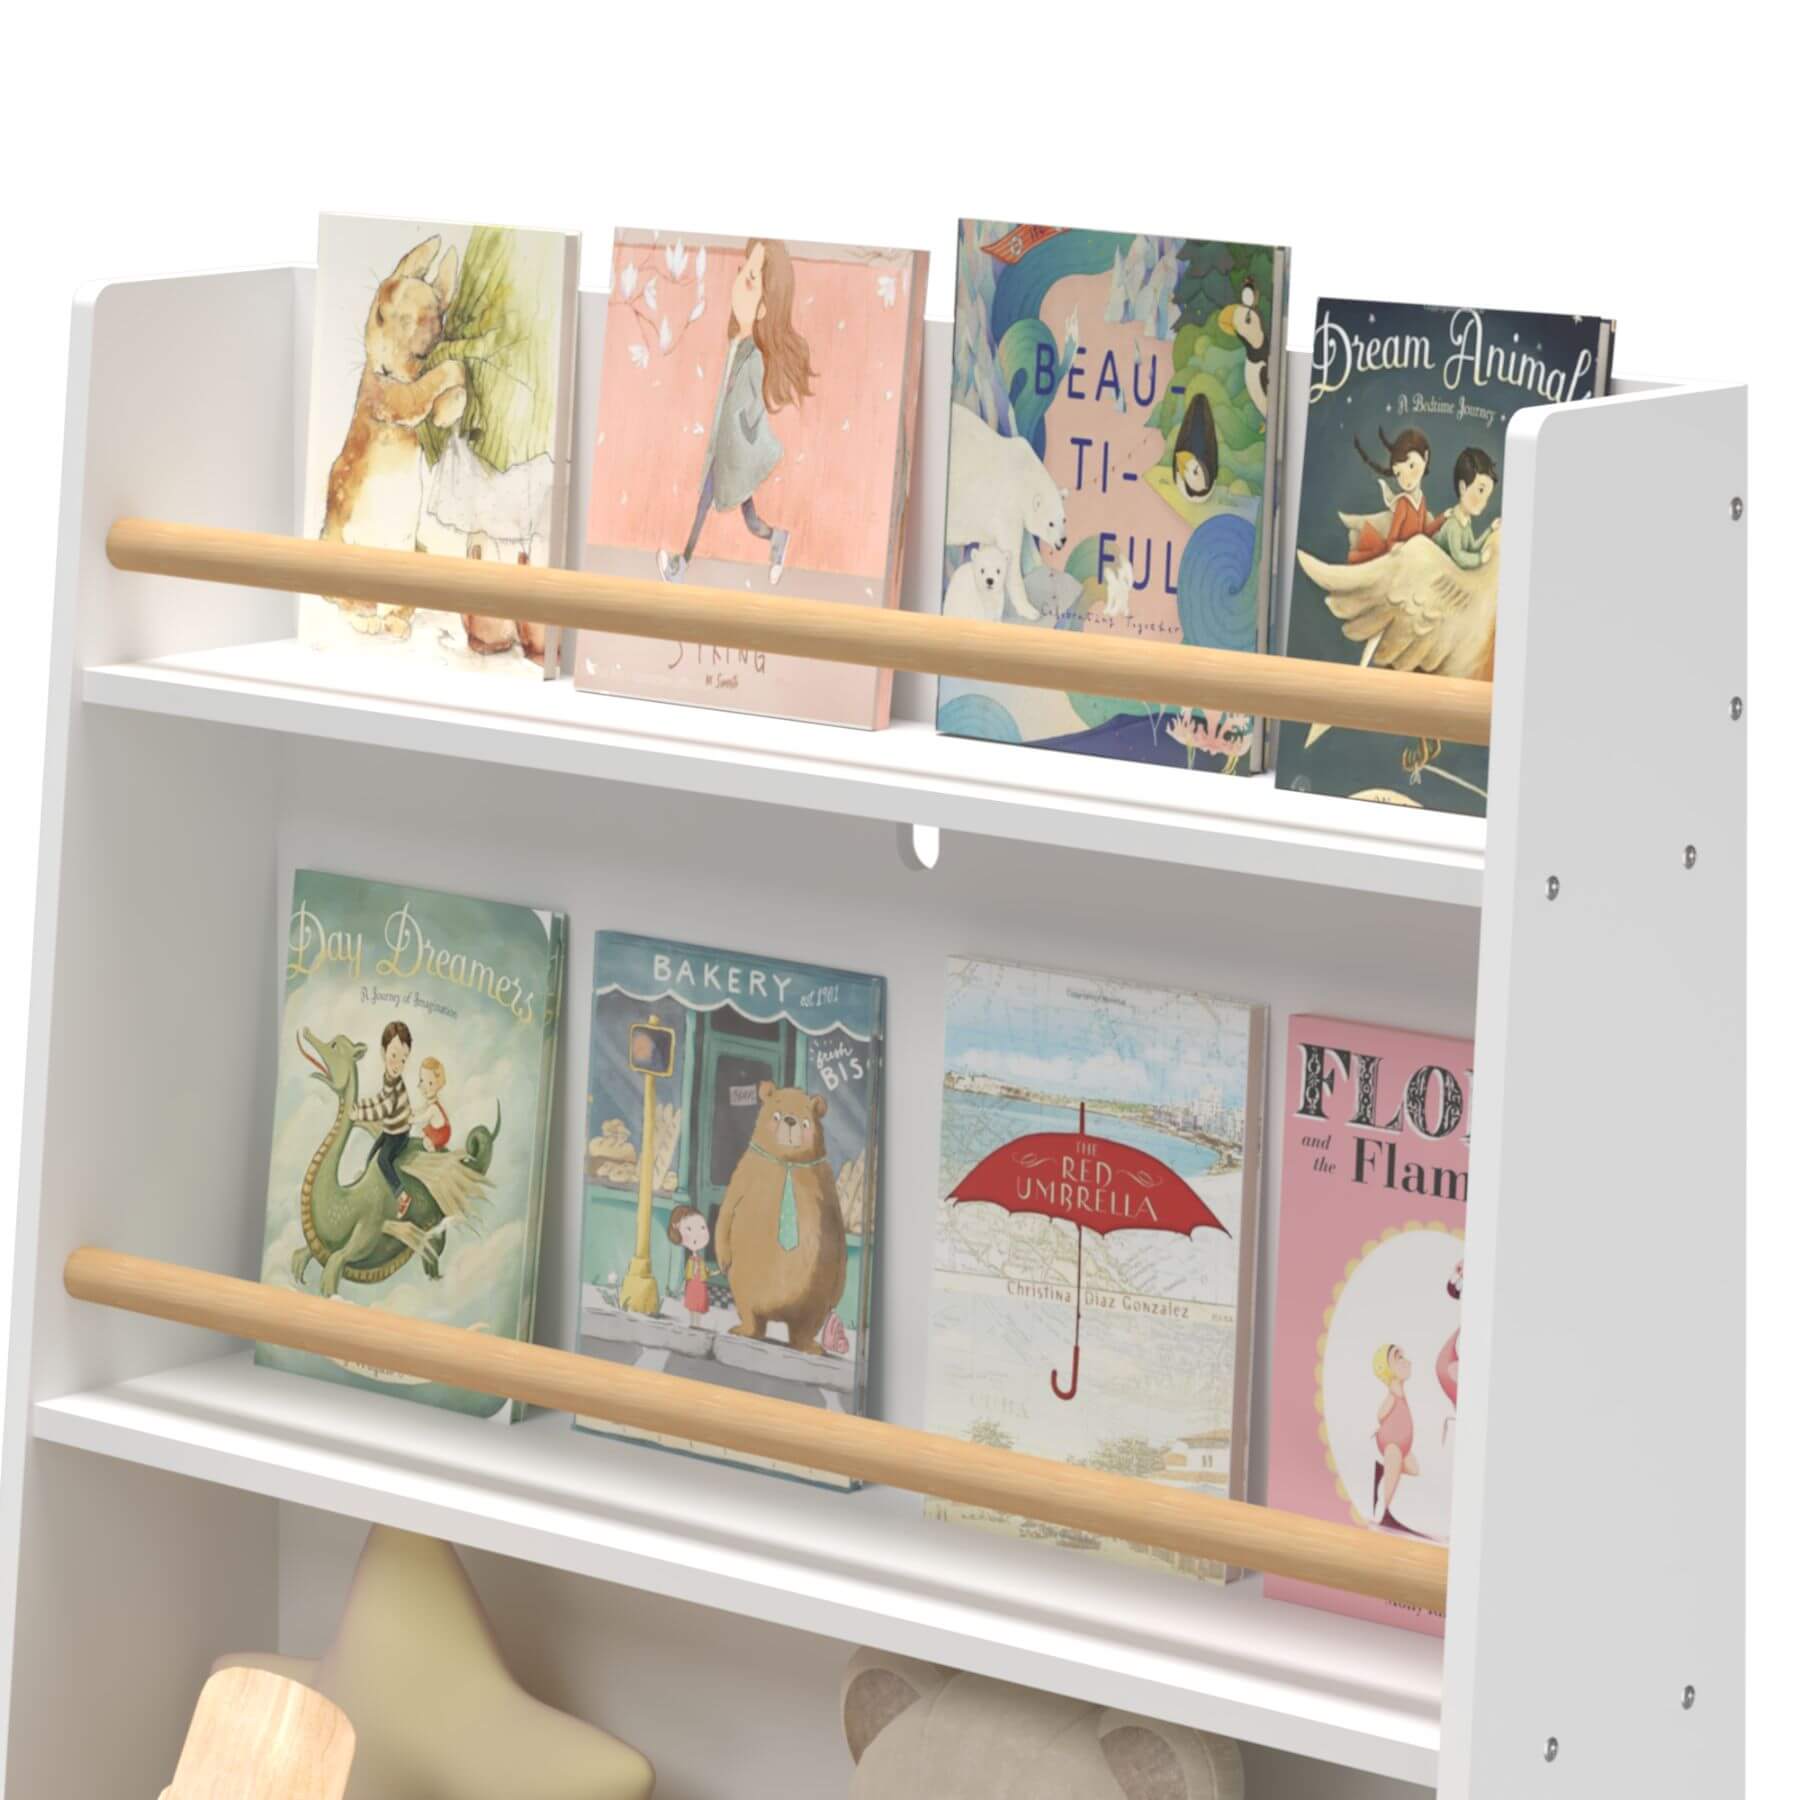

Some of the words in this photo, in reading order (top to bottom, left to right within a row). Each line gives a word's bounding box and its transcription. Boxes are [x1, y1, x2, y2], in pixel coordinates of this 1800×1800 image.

[1035, 342, 1185, 407] BEAU-
[1308, 310, 1435, 404] Dream
[1443, 307, 1593, 403] Animal
[1397, 393, 1408, 416] A
[1456, 395, 1497, 428] Journey
[1070, 437, 1138, 494] TI-
[1097, 532, 1178, 594] FUL
[1125, 615, 1180, 635] Together
[287, 900, 363, 980] Day
[375, 900, 534, 1025] Dreamers
[652, 953, 792, 1003] BAKERY
[371, 986, 400, 1008] Journey
[816, 1041, 854, 1069] fresh
[1292, 1041, 1474, 1144] FLO
[1076, 1141, 1097, 1156] THE
[1301, 1134, 1332, 1150] and
[1061, 1155, 1113, 1188] RED
[1313, 1156, 1337, 1174] the
[1351, 1135, 1468, 1203] Flam
[1016, 1175, 1158, 1222] UMBRELLA
[1006, 1279, 1072, 1304] Christina
[1085, 1291, 1116, 1310] Diaz
[1121, 1296, 1189, 1319] Gonzalez
